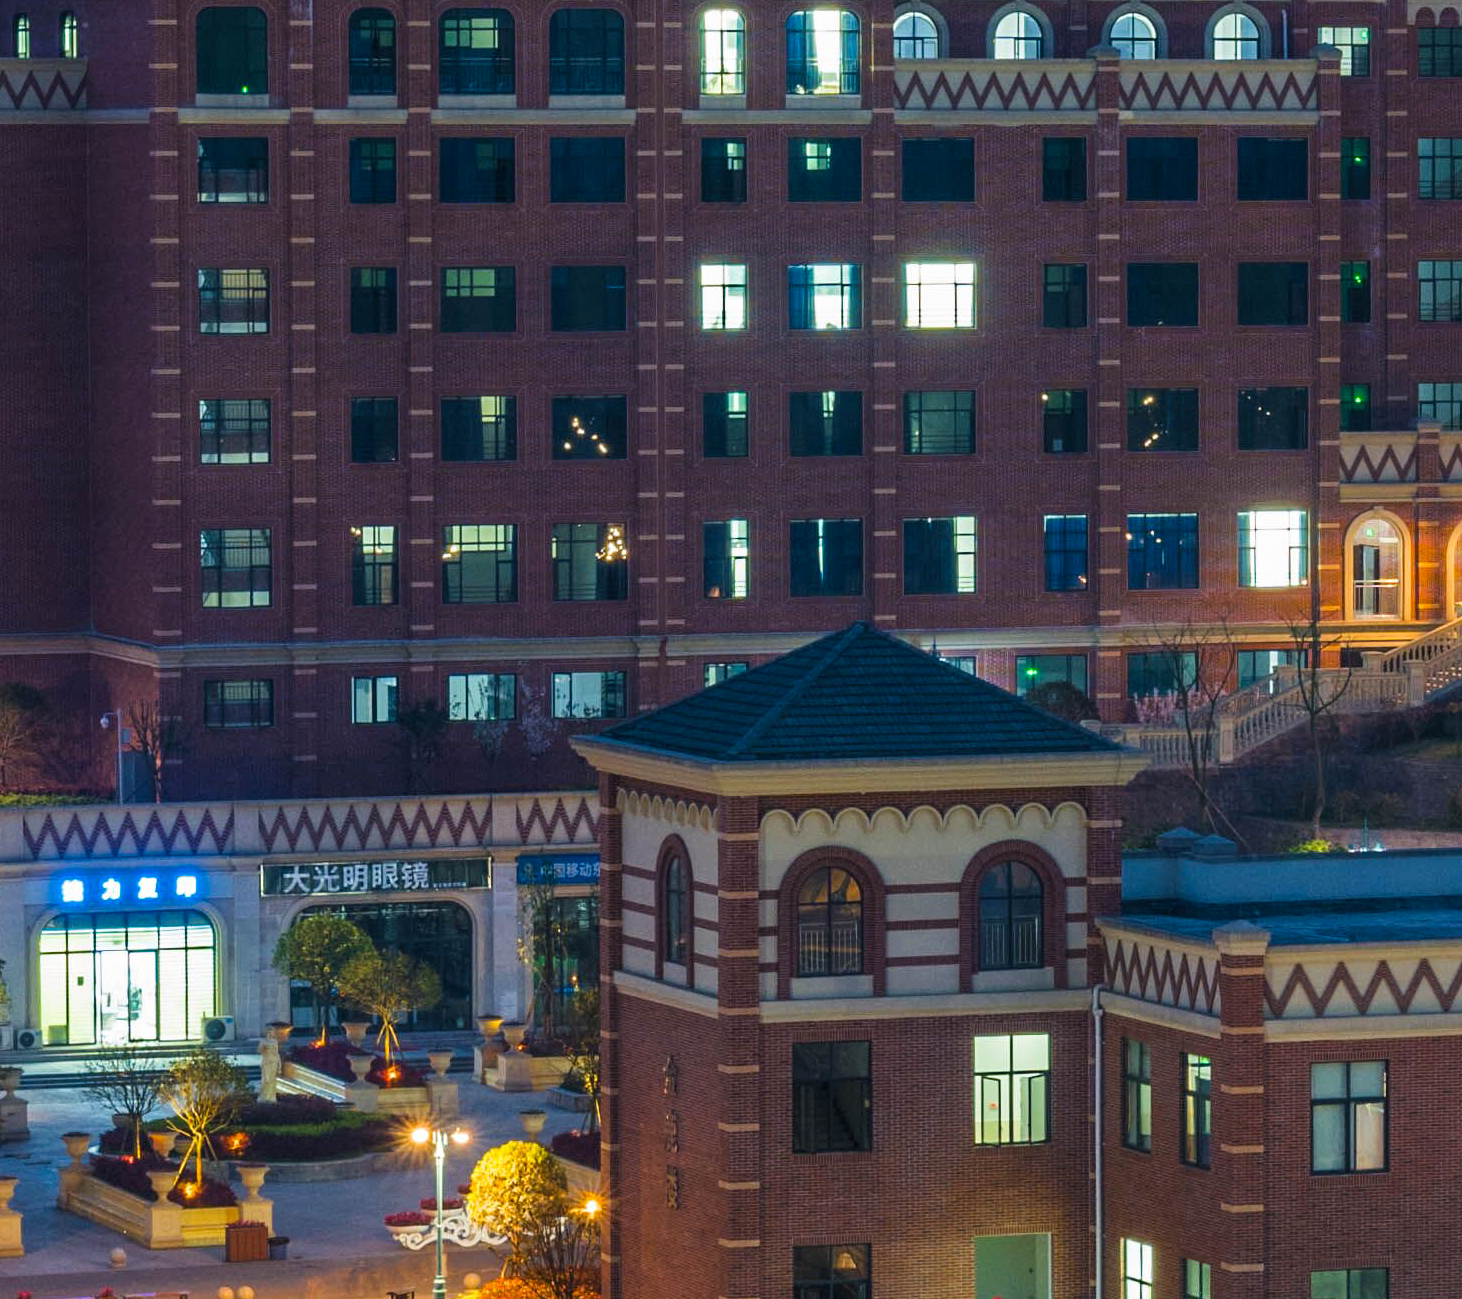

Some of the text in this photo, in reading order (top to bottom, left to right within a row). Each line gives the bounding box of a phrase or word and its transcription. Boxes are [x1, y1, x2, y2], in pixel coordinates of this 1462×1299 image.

[283, 861, 430, 894] 大光明眼镜
